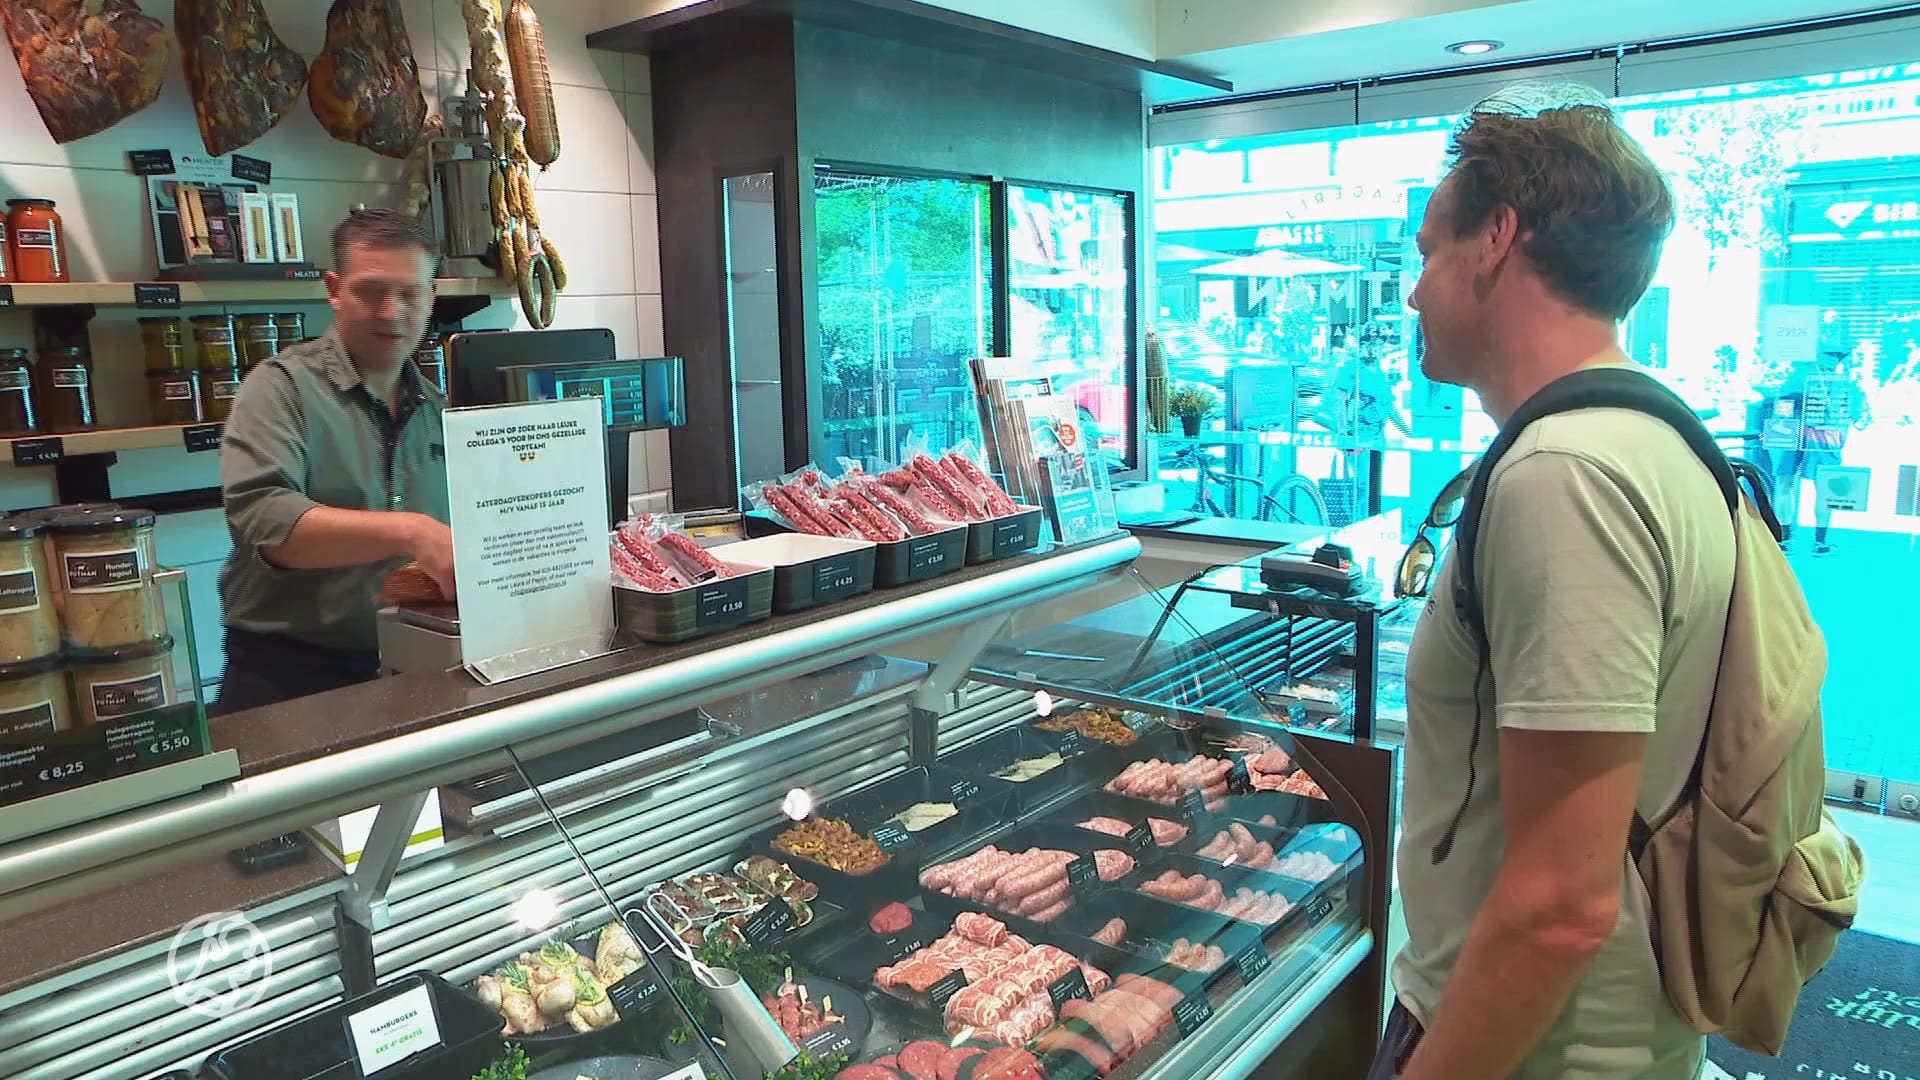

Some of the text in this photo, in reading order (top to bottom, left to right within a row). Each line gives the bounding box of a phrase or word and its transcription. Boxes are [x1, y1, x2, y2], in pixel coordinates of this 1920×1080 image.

[475, 429, 488, 437] WIJ
[490, 428, 505, 436] ZIJN
[518, 424, 536, 432] ZOEK
[536, 422, 556, 430] NAAR
[557, 420, 578, 429] LEUKE
[466, 437, 506, 448] COLLEGA'S
[506, 434, 526, 443] VOOR
[552, 428, 586, 438] GEZELLIGE
[512, 442, 546, 452] TOPTEAM!
[476, 486, 584, 508] ZATERDAGVERKOPERS GEZOCHT
[500, 506, 514, 515] M/V
[516, 502, 538, 512] VANAF
[548, 498, 565, 508] JAAR
[150, 743, 159, 753] €
[162, 736, 190, 751] 5,50
[40, 760, 84, 780] € 8,25
[370, 1010, 418, 1036] HAMBURGERS
[400, 1028, 424, 1044] GRATIS
